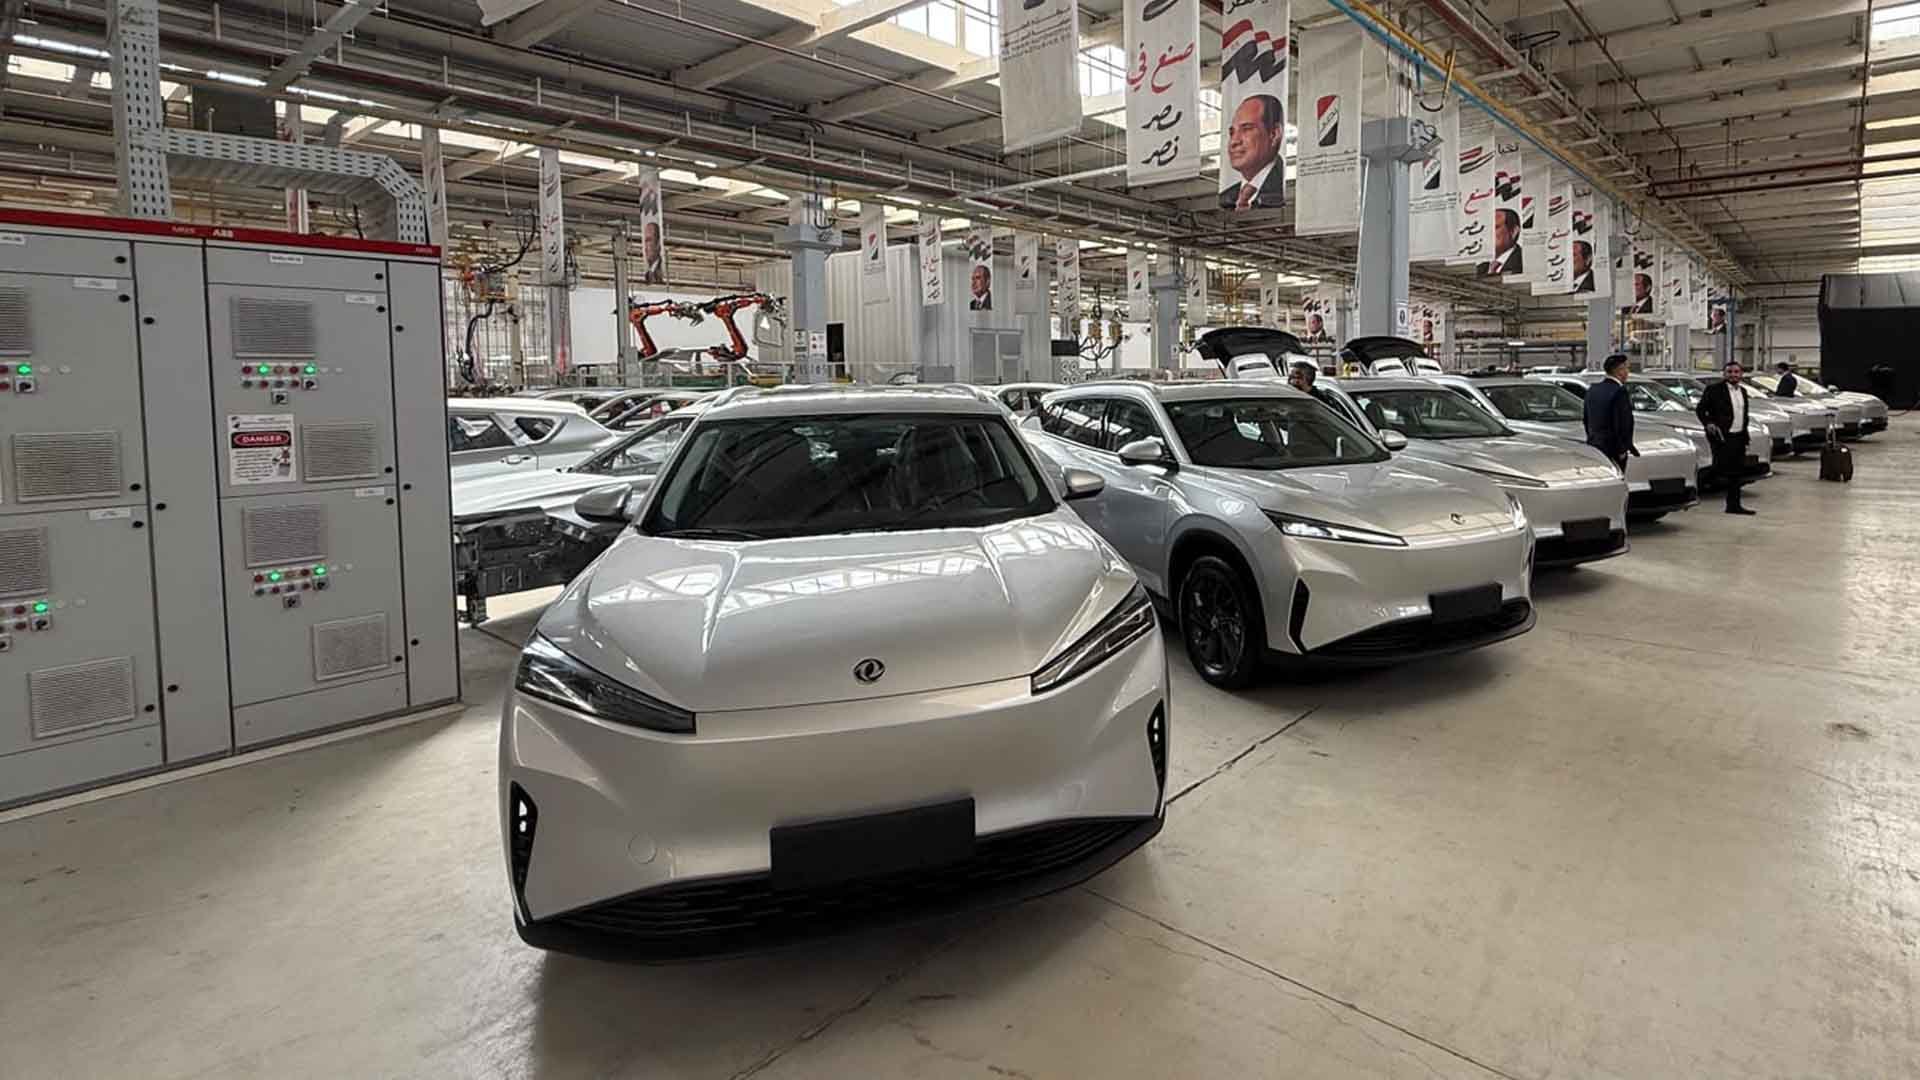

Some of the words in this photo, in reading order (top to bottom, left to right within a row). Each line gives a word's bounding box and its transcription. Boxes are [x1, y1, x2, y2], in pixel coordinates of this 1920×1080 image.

[1126, 42, 1148, 92] في
[1151, 42, 1194, 93] صنع
[1141, 104, 1183, 131] مصر
[1141, 135, 1180, 166] نصر
[1464, 188, 1494, 215] صنع
[212, 228, 234, 239] ABB
[1459, 221, 1485, 236] مصر
[1458, 238, 1483, 255] نصر
[242, 435, 282, 443] DANGER
